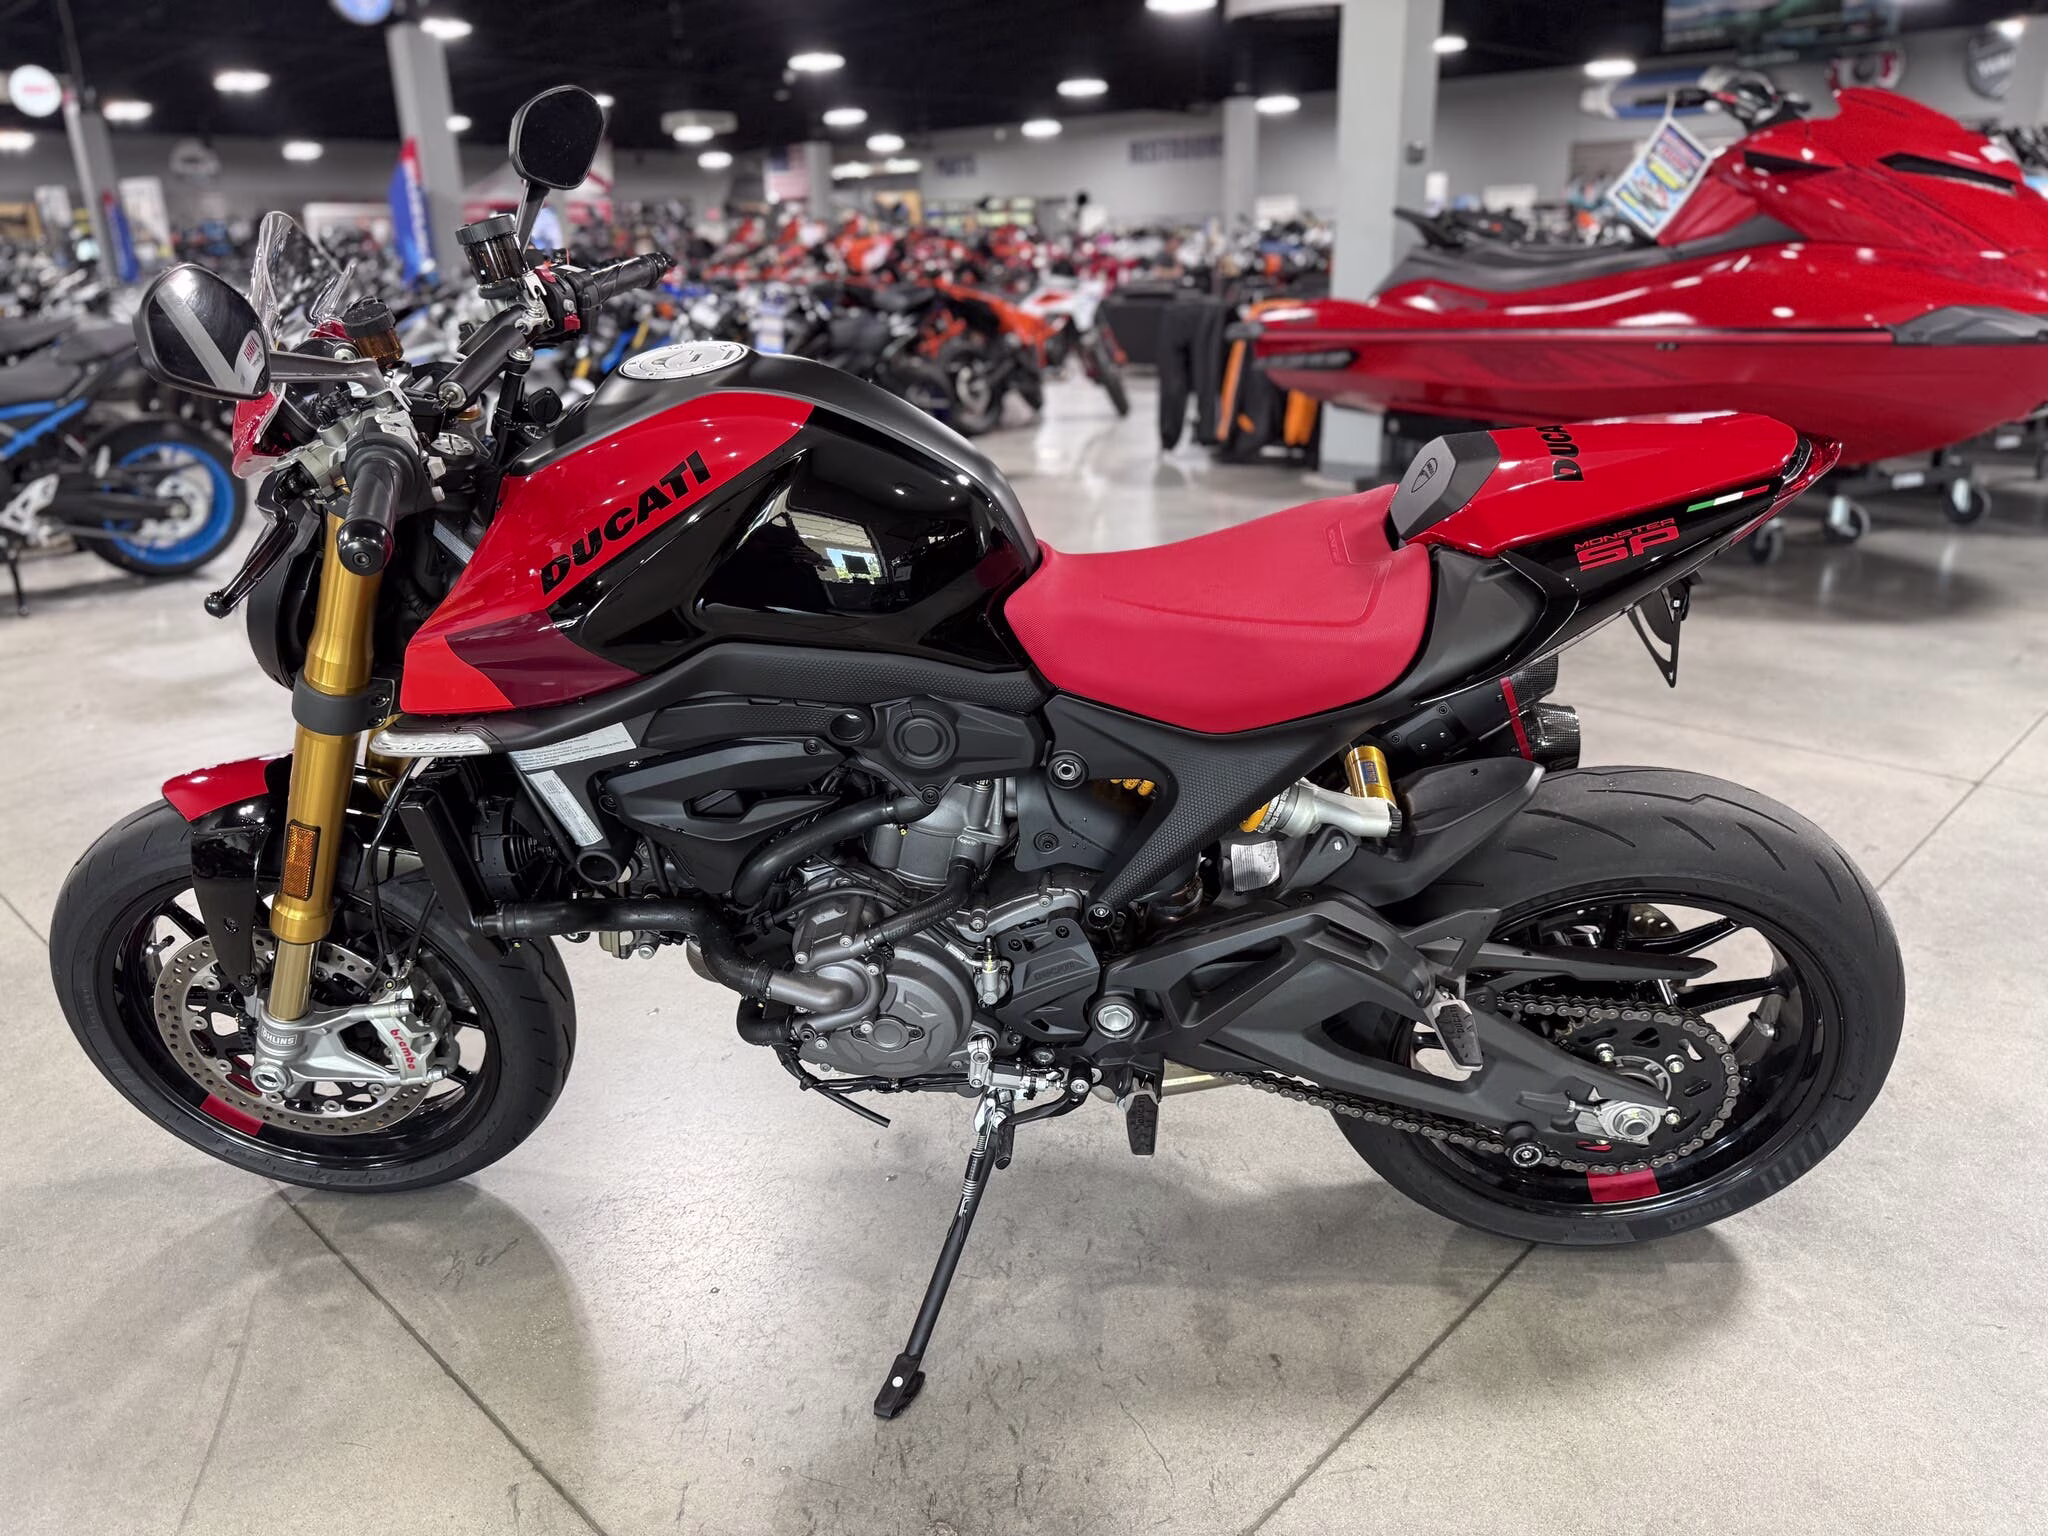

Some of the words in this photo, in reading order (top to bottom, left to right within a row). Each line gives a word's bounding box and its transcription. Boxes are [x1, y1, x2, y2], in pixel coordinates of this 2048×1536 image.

[540, 450, 712, 596] DUCATI
[1574, 517, 1676, 551] MONSTER
[1577, 525, 1681, 571] SP
[390, 1028, 416, 1070] brembo
